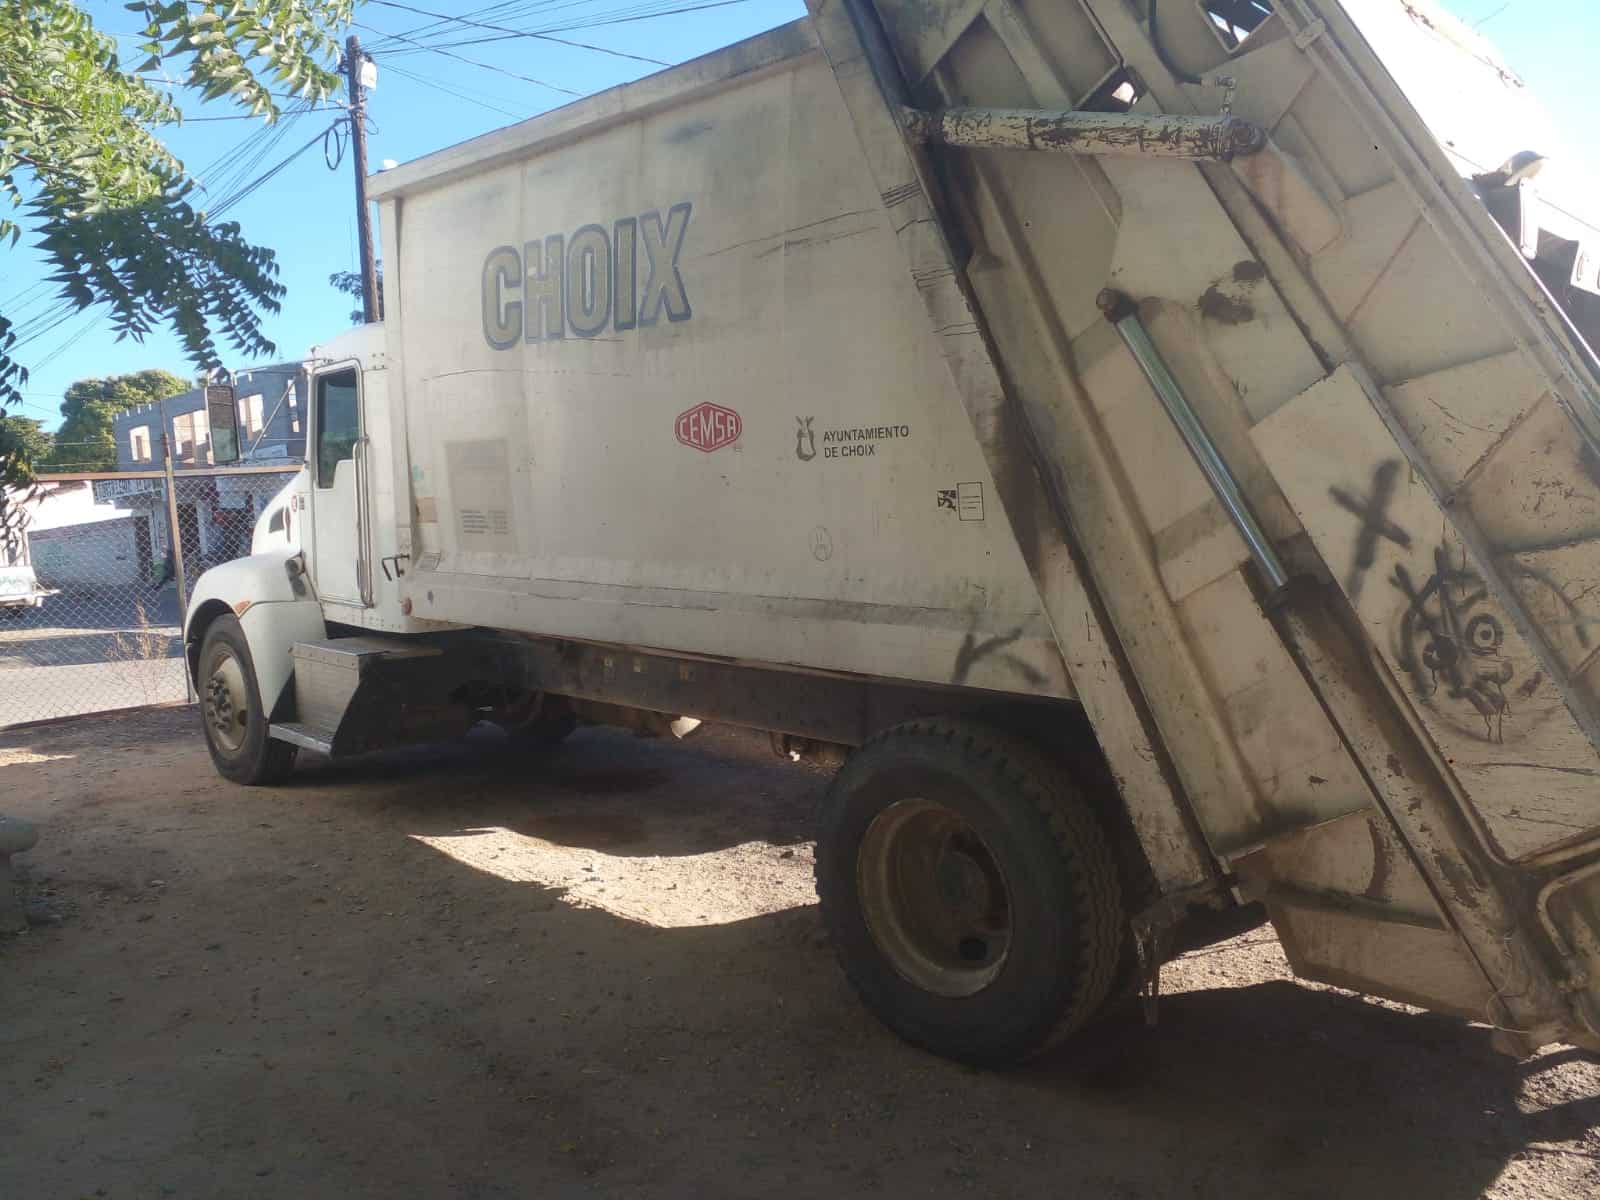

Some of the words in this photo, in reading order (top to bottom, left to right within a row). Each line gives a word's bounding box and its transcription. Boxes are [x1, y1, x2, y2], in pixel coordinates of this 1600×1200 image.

[482, 202, 691, 350] CHOIX
[680, 409, 737, 447] CEMSA
[823, 425, 910, 442] AYUNTAMIENTO
[824, 446, 839, 458] DE
[841, 444, 876, 457] CHOIX
